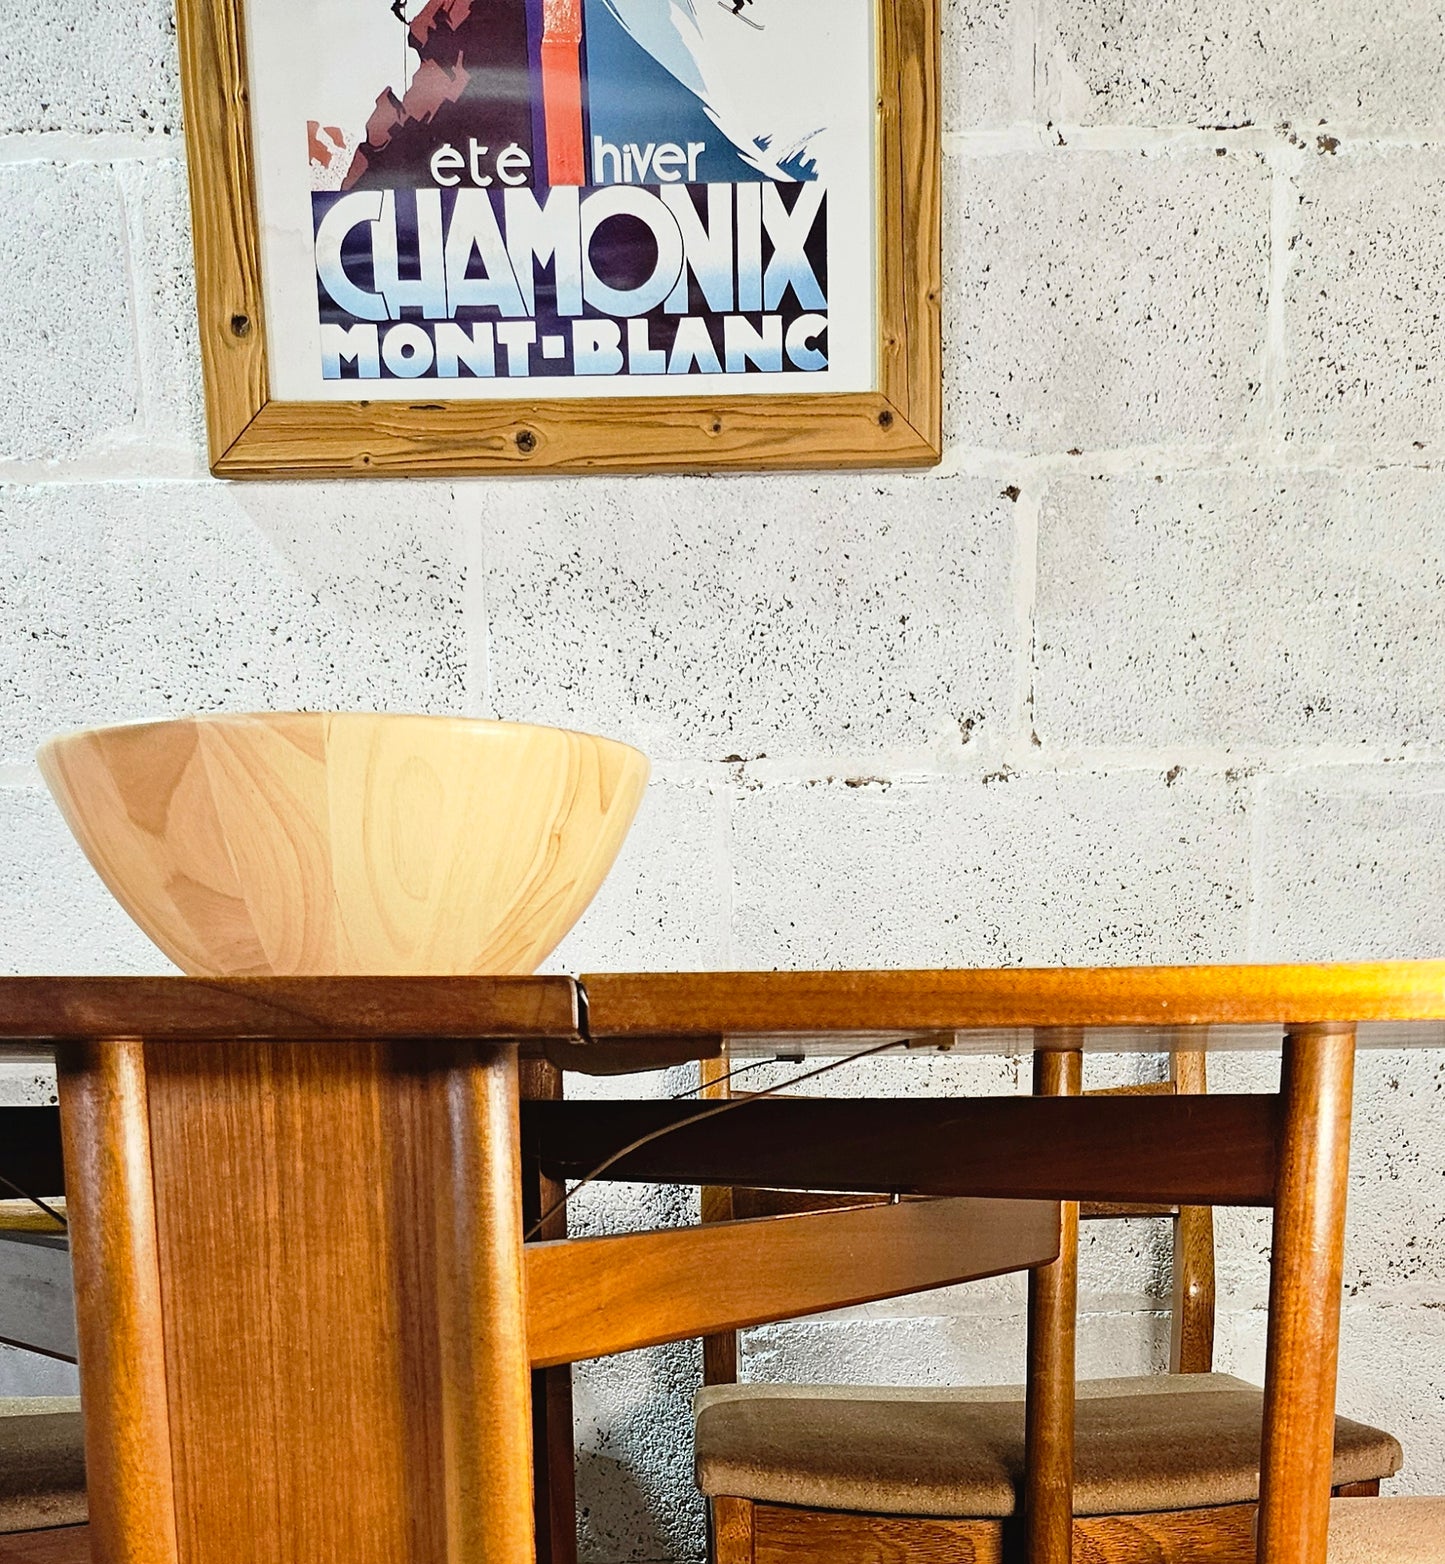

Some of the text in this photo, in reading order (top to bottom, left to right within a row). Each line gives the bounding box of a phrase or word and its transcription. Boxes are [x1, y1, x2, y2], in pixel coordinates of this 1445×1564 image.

[430, 135, 706, 187] été hiver
[315, 182, 828, 320] CHAMONIX
[322, 314, 828, 377] MONT-BLANC
